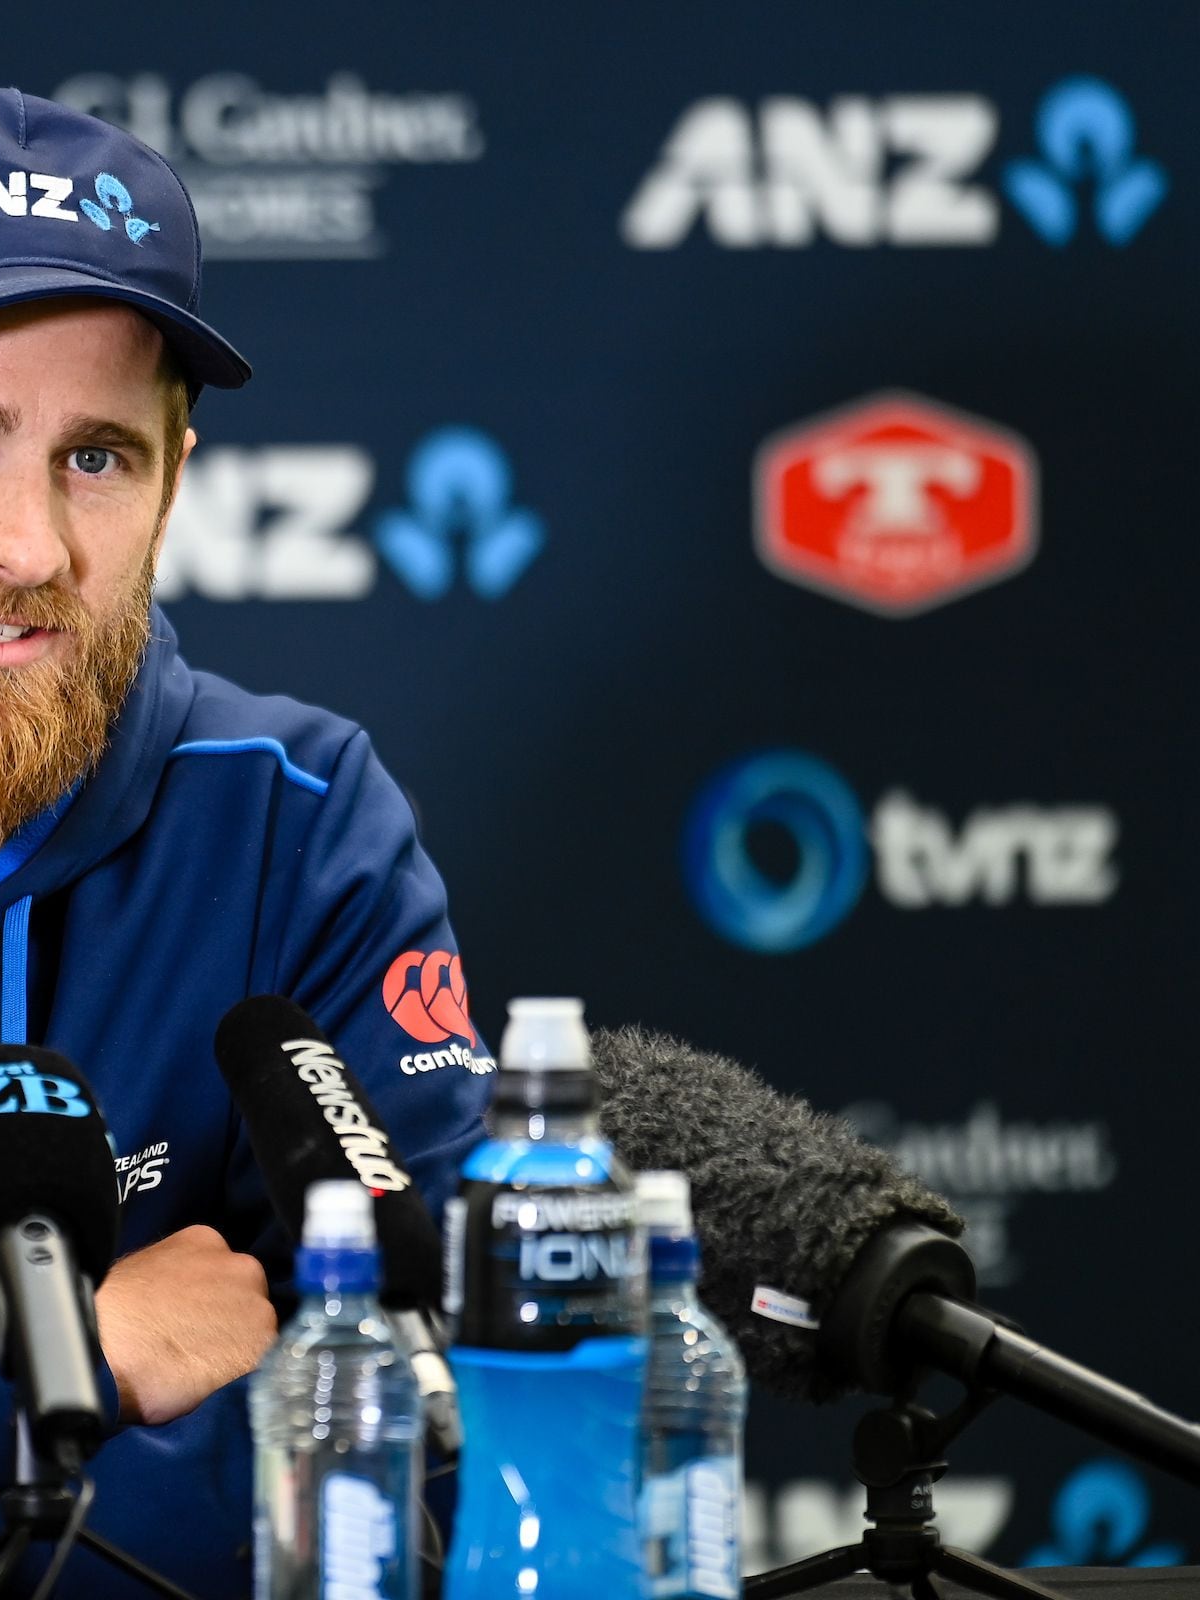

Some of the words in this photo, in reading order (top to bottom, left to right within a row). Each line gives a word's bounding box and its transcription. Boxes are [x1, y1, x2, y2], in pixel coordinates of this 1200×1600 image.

[621, 95, 1000, 248] ANZ
[152, 445, 377, 601] NZ
[872, 790, 1121, 905] tvnz
[281, 1038, 412, 1192] Newshub
